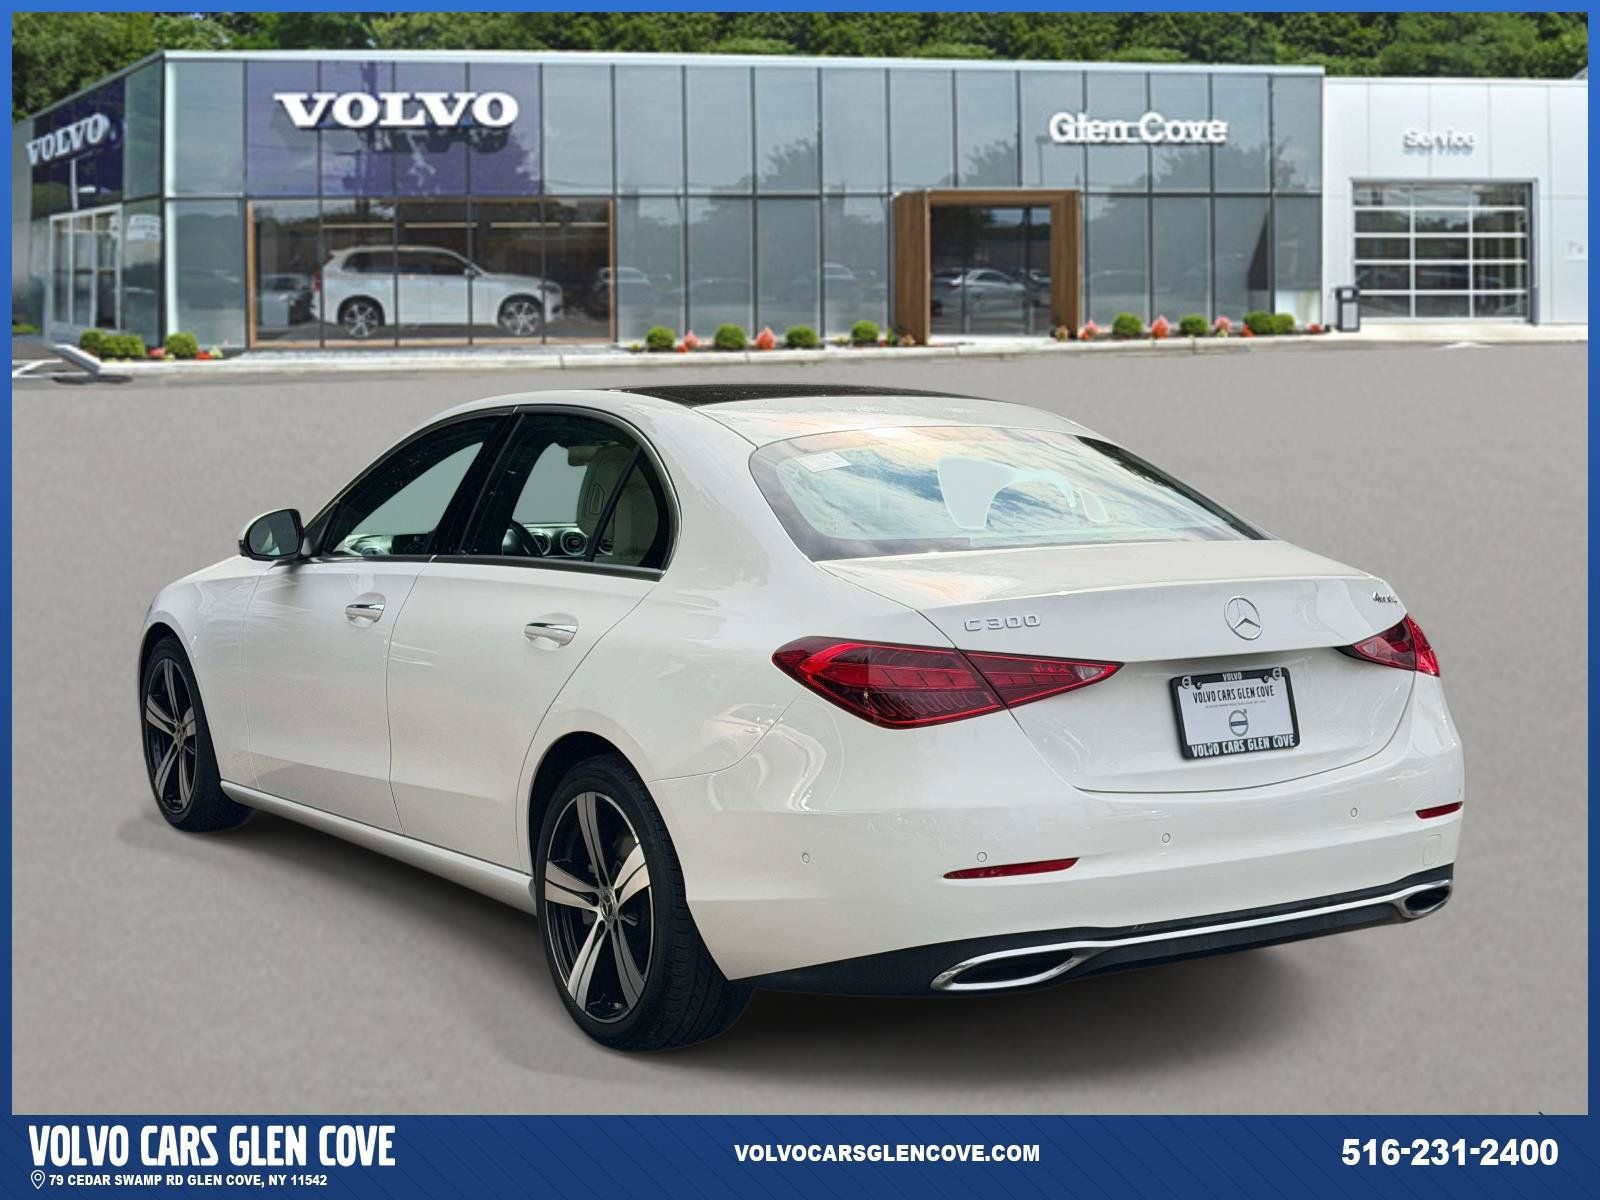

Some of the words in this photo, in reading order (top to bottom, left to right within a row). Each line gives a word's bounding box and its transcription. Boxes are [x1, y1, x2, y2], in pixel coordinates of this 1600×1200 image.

[274, 92, 519, 128] VOLVO
[27, 112, 111, 165] VOLVO
[1049, 112, 1128, 143] Glen
[1139, 112, 1228, 143] Cove
[1402, 127, 1477, 152] Service
[963, 618, 982, 632] C
[986, 614, 1041, 630] 300
[1222, 671, 1243, 682] VOLVO
[1192, 690, 1217, 704] VOLVO
[1217, 688, 1237, 702] CARS
[1237, 686, 1256, 700] GLEN
[1256, 684, 1275, 698] COVE
[1191, 742, 1220, 758] VOLVO
[1222, 739, 1246, 754] CARS
[1247, 736, 1271, 751] GLEN
[1272, 734, 1296, 748] COVE
